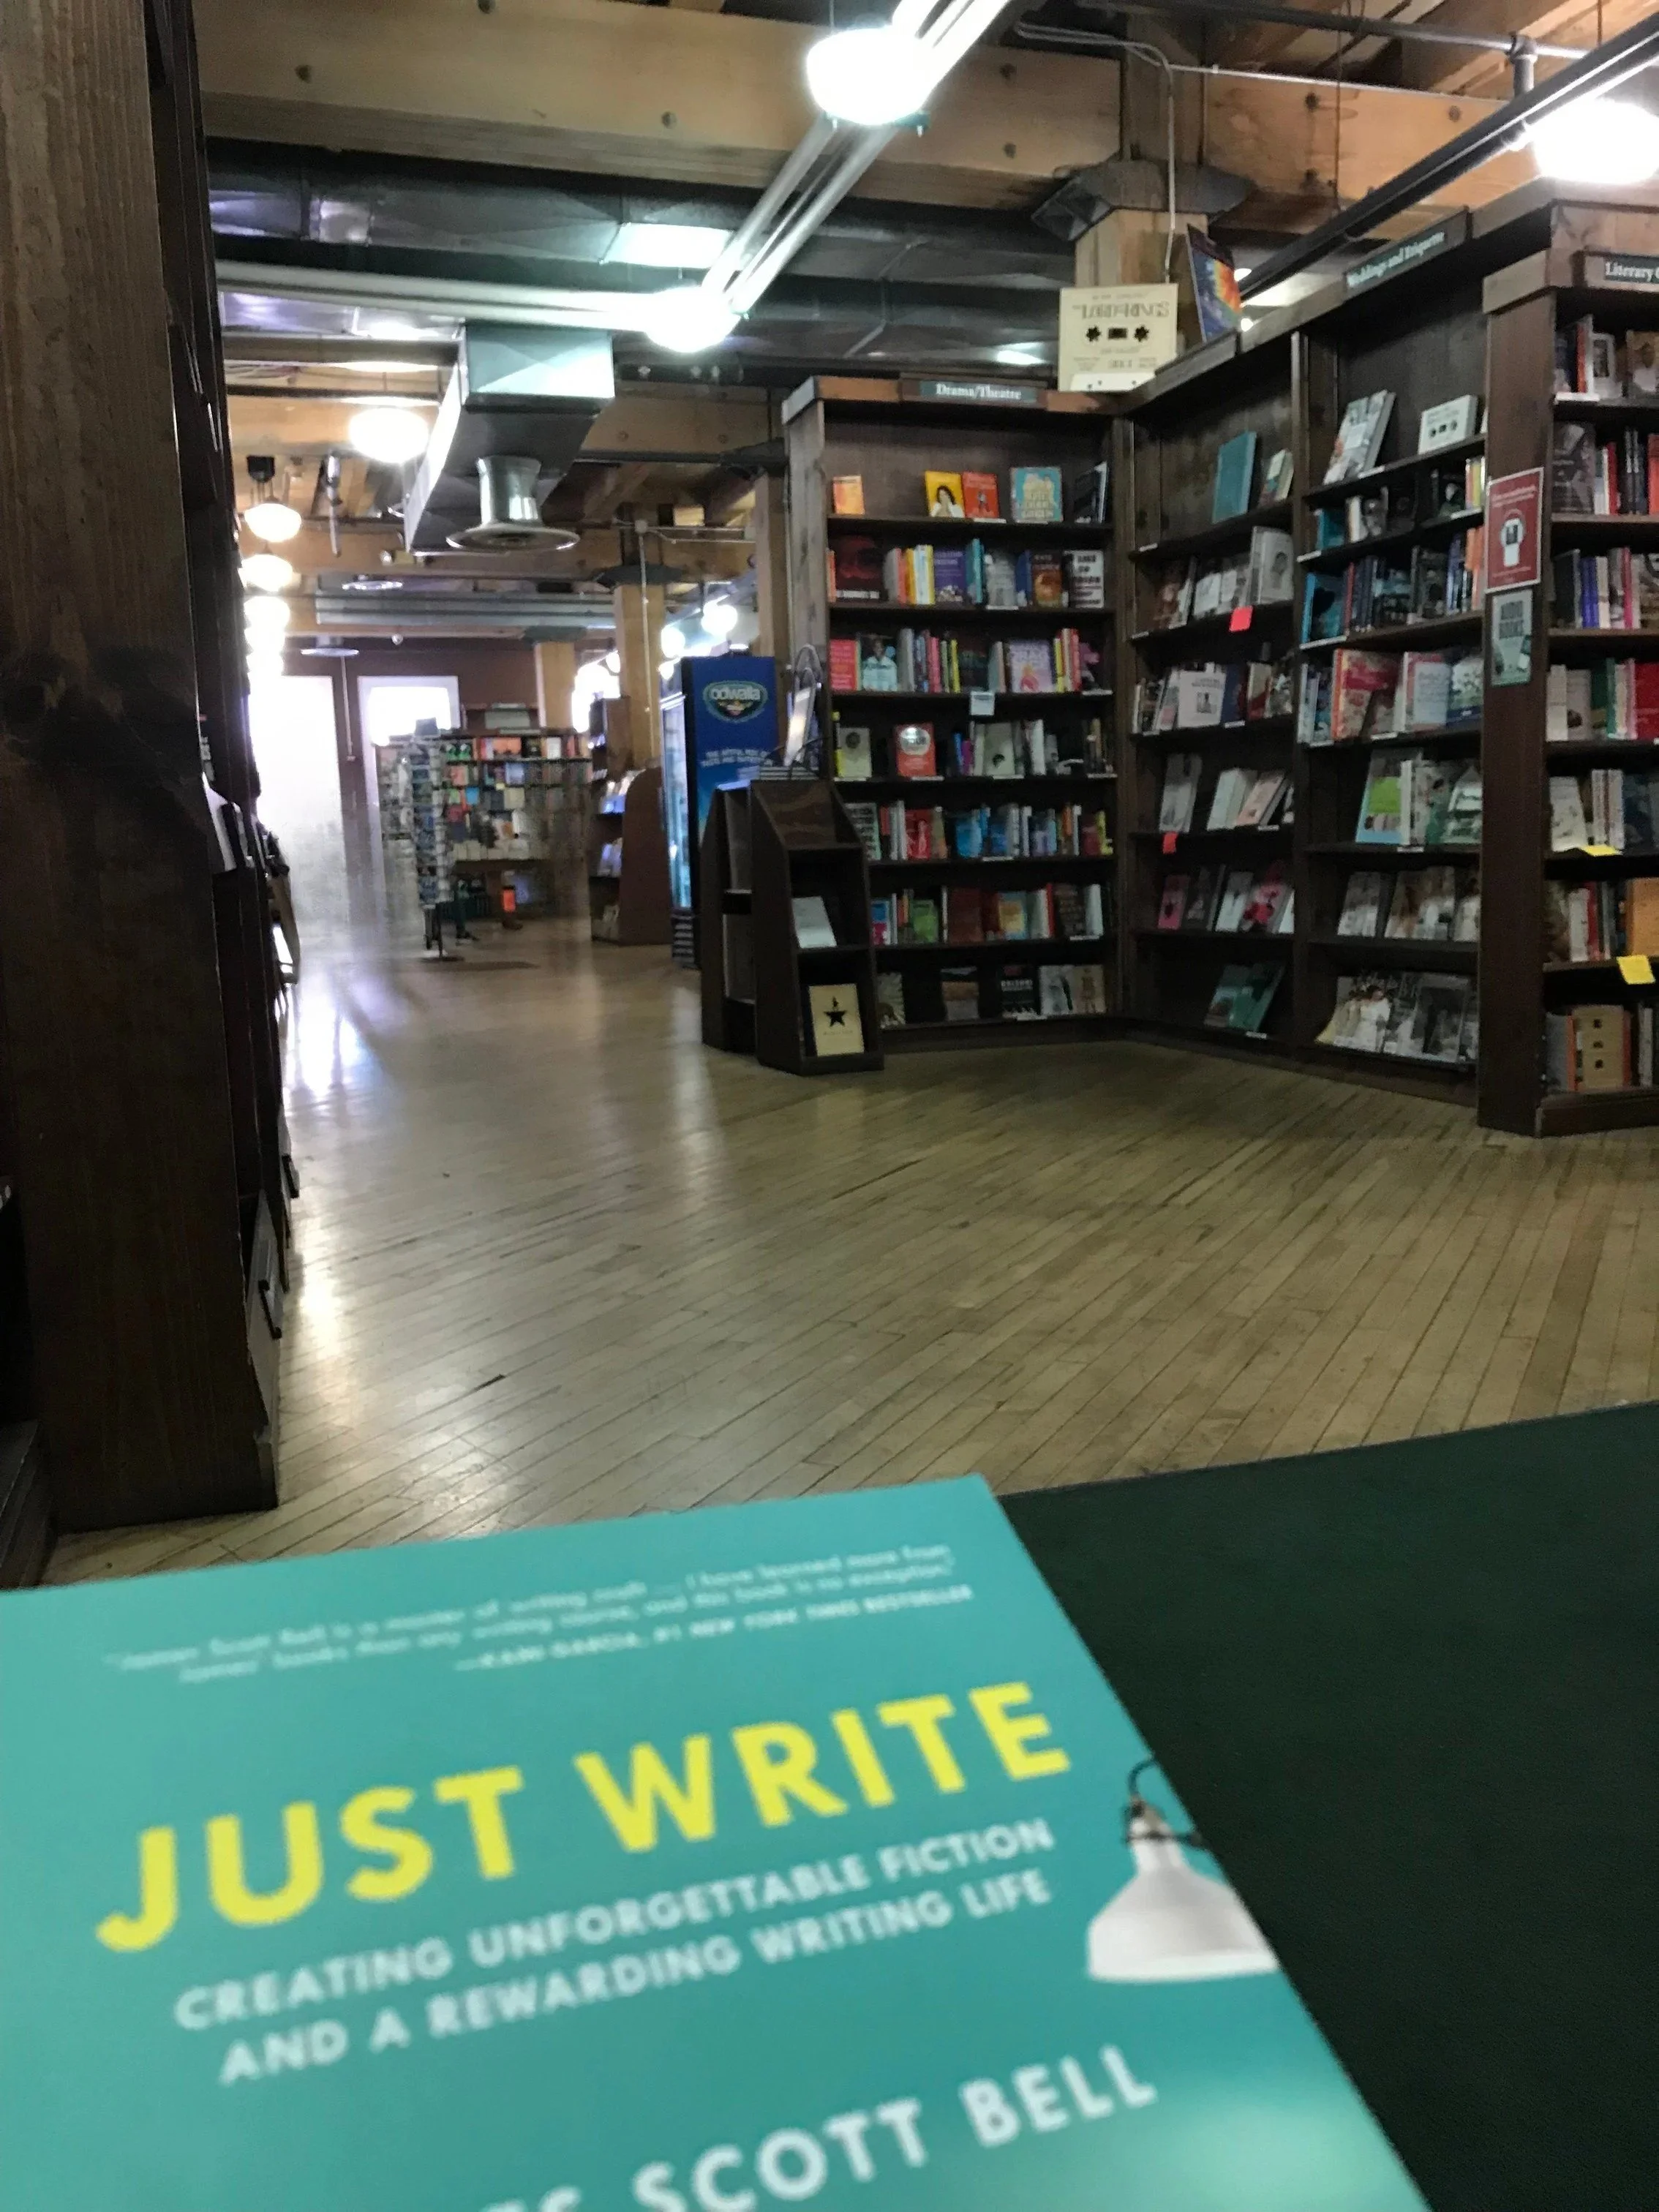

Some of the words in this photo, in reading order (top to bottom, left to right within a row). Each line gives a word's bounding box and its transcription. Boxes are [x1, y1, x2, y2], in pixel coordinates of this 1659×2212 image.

[1605, 262, 1653, 282] Literary
[96, 1764, 524, 1952] JUST
[573, 1680, 1071, 1854] WRITE
[173, 1936, 454, 2031] CREATING
[467, 1853, 871, 1968] UNFORGETTABLE
[877, 1817, 1056, 1882] FICTION
[219, 2018, 350, 2086] AND
[369, 2006, 412, 2052] A
[426, 1934, 742, 2039] REWARDING
[749, 1890, 953, 1964] WRITING
[959, 1868, 1052, 1920] LIFE
[631, 2096, 928, 2212] SCOTT
[958, 2044, 1157, 2148] BELL
